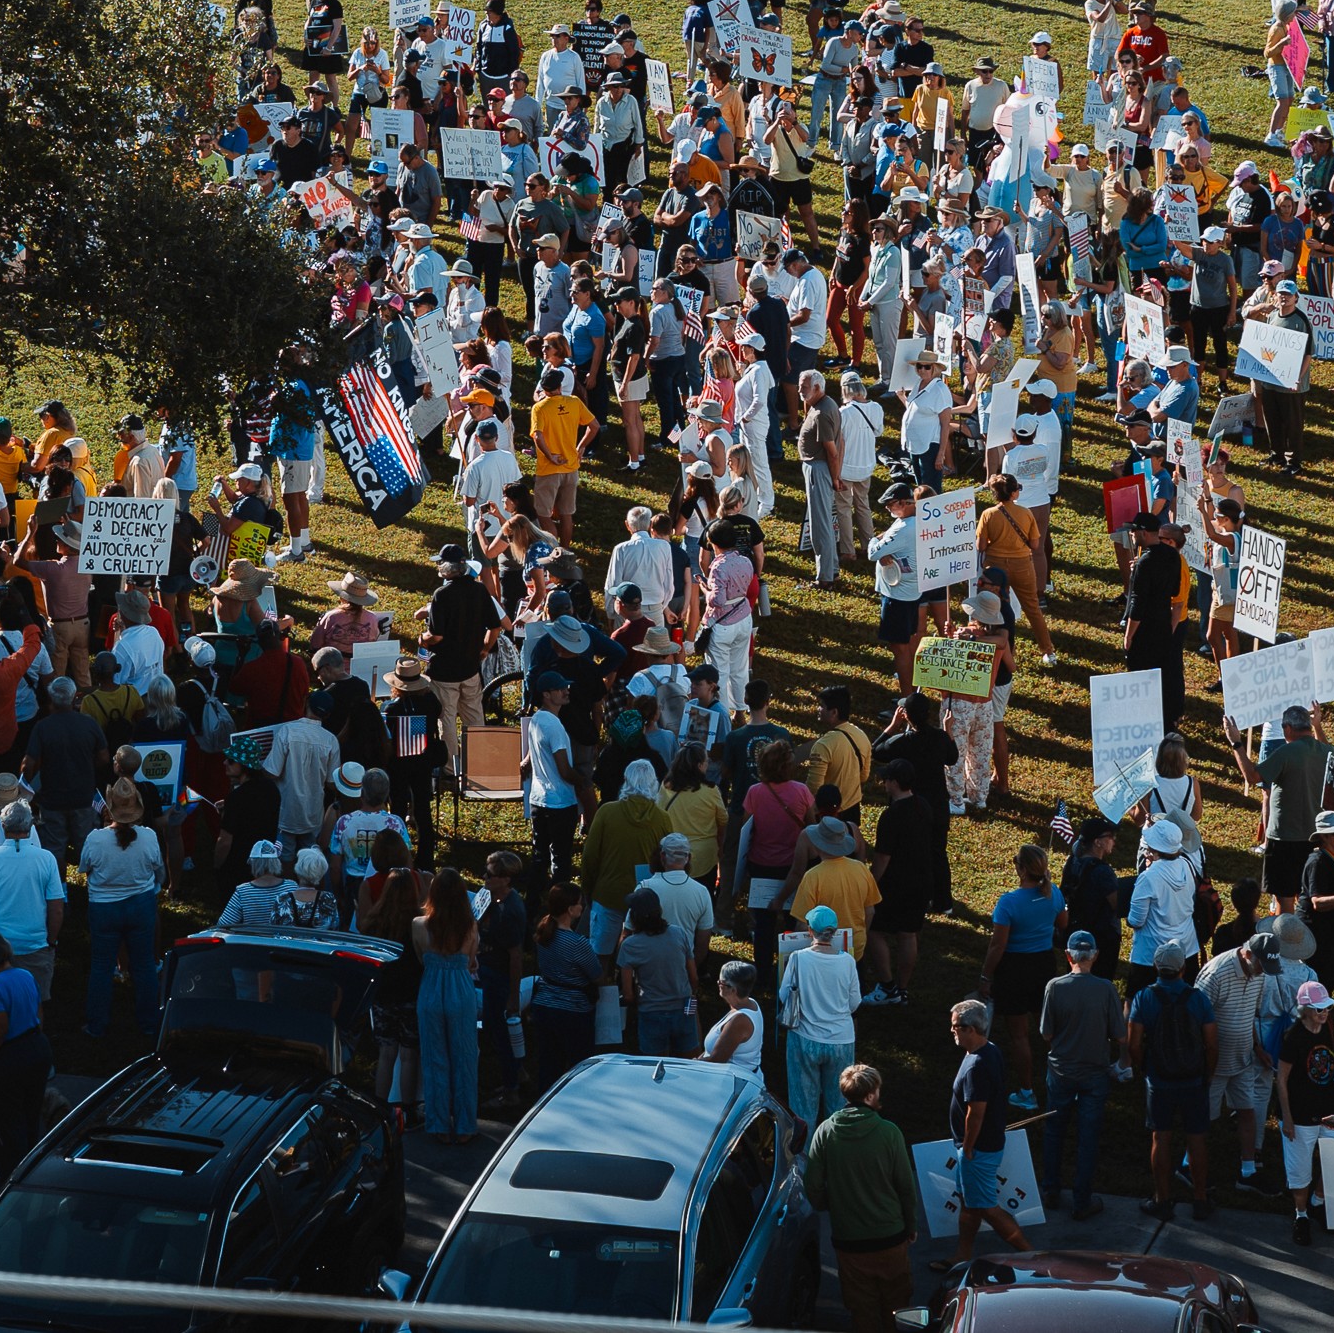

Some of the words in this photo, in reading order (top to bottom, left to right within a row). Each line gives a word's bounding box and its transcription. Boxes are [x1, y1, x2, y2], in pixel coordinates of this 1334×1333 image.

[402, 4, 421, 15] DEFEND
[450, 8, 470, 27] NO
[447, 26, 473, 46] KINGS
[741, 34, 761, 46] ORANGE
[1130, 35, 1153, 46] USMC
[585, 54, 601, 62] STAY
[1299, 110, 1323, 119] HONOR
[303, 181, 327, 210] NO
[739, 190, 762, 203] RIP
[321, 194, 351, 217] KINGS
[419, 324, 432, 343] I
[436, 317, 451, 332] AM
[1255, 324, 1267, 342] NO
[1270, 329, 1303, 352] KINGS
[1239, 358, 1247, 371] IN
[1250, 362, 1291, 381] AMERICA!
[369, 347, 392, 378] NO
[387, 384, 416, 445] KINGS
[88, 500, 164, 521] DEMOCRACY
[921, 501, 941, 521] So
[955, 509, 966, 521] UP
[110, 522, 167, 538] DECENCY
[919, 523, 946, 541] that
[953, 521, 975, 535] even
[82, 543, 159, 558] AUTOCRACY
[1242, 527, 1283, 571] HANDS
[101, 559, 164, 574] CRUELTY
[1235, 597, 1276, 629] DEMOCRACY
[148, 753, 167, 763] TAX
[145, 767, 168, 777] RICH
